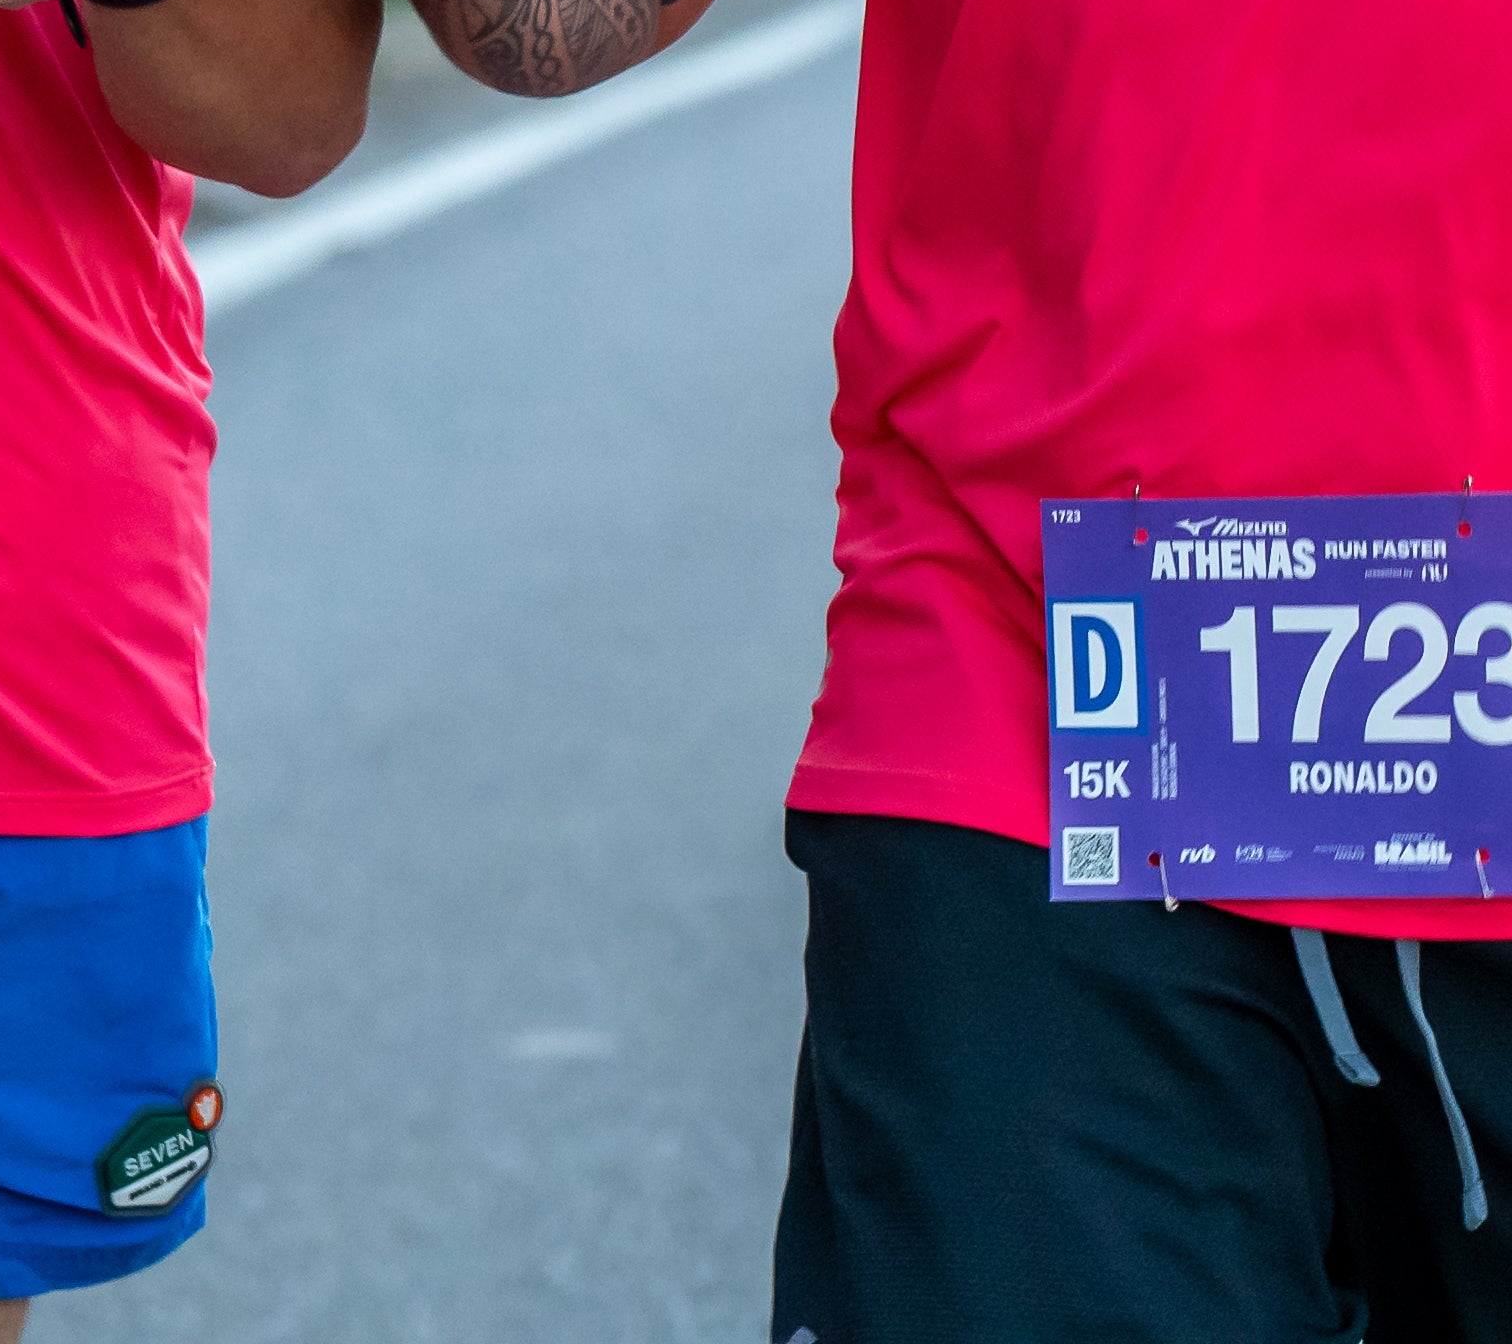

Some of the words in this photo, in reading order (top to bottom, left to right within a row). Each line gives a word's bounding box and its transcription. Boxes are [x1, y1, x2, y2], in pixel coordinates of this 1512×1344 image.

[1051, 511, 1081, 523] 1723
[1151, 538, 1316, 580] ATHENAS
[1325, 540, 1367, 559] RUN
[1372, 539, 1448, 560] FASTER
[1071, 615, 1122, 713] D
[1063, 761, 1131, 798] 15K
[1290, 761, 1438, 795] RONALDO
[124, 1128, 194, 1178] SEVEN
